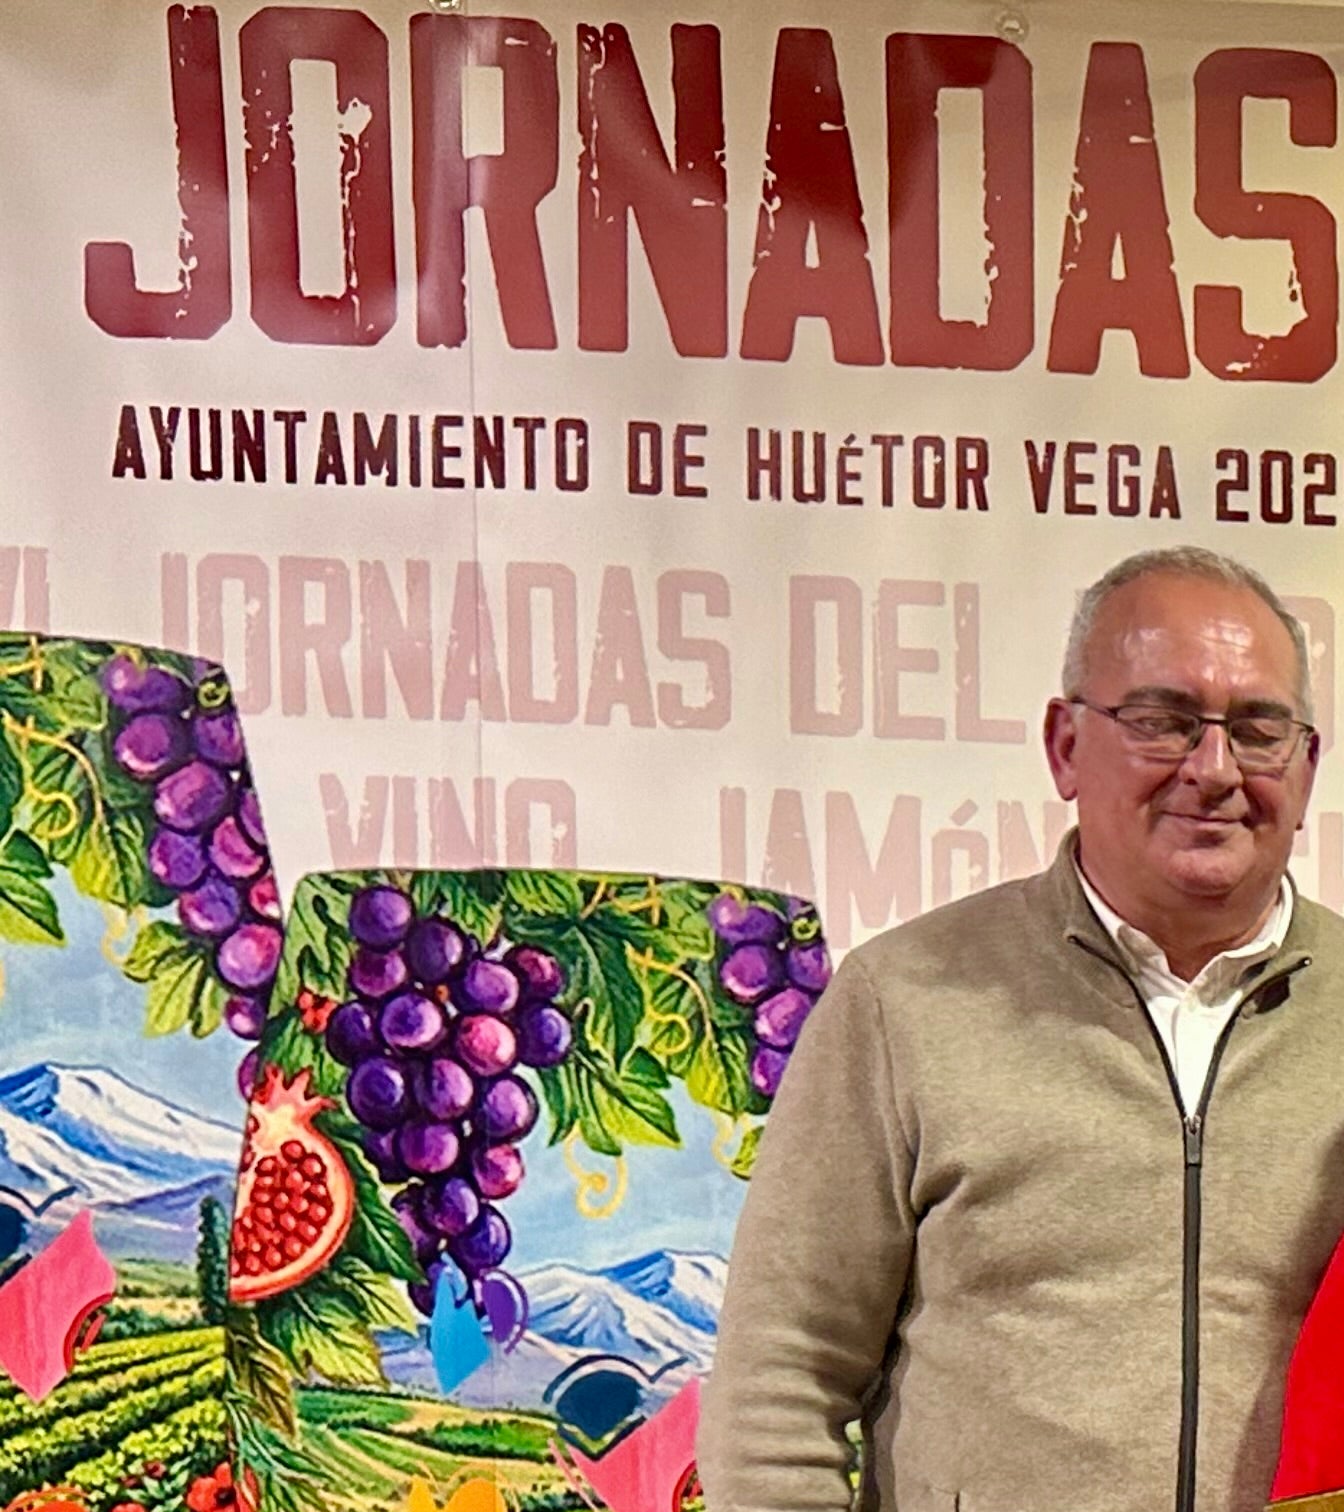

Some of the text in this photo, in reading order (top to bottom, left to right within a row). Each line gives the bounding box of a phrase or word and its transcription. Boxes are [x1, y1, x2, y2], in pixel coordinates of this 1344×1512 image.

[85, 4, 1338, 382] JORNADAS
[112, 404, 592, 492] AYUNTAMIENTO
[628, 420, 707, 500] DE
[1027, 439, 1182, 520] VEGA
[789, 573, 1027, 744] DEL
